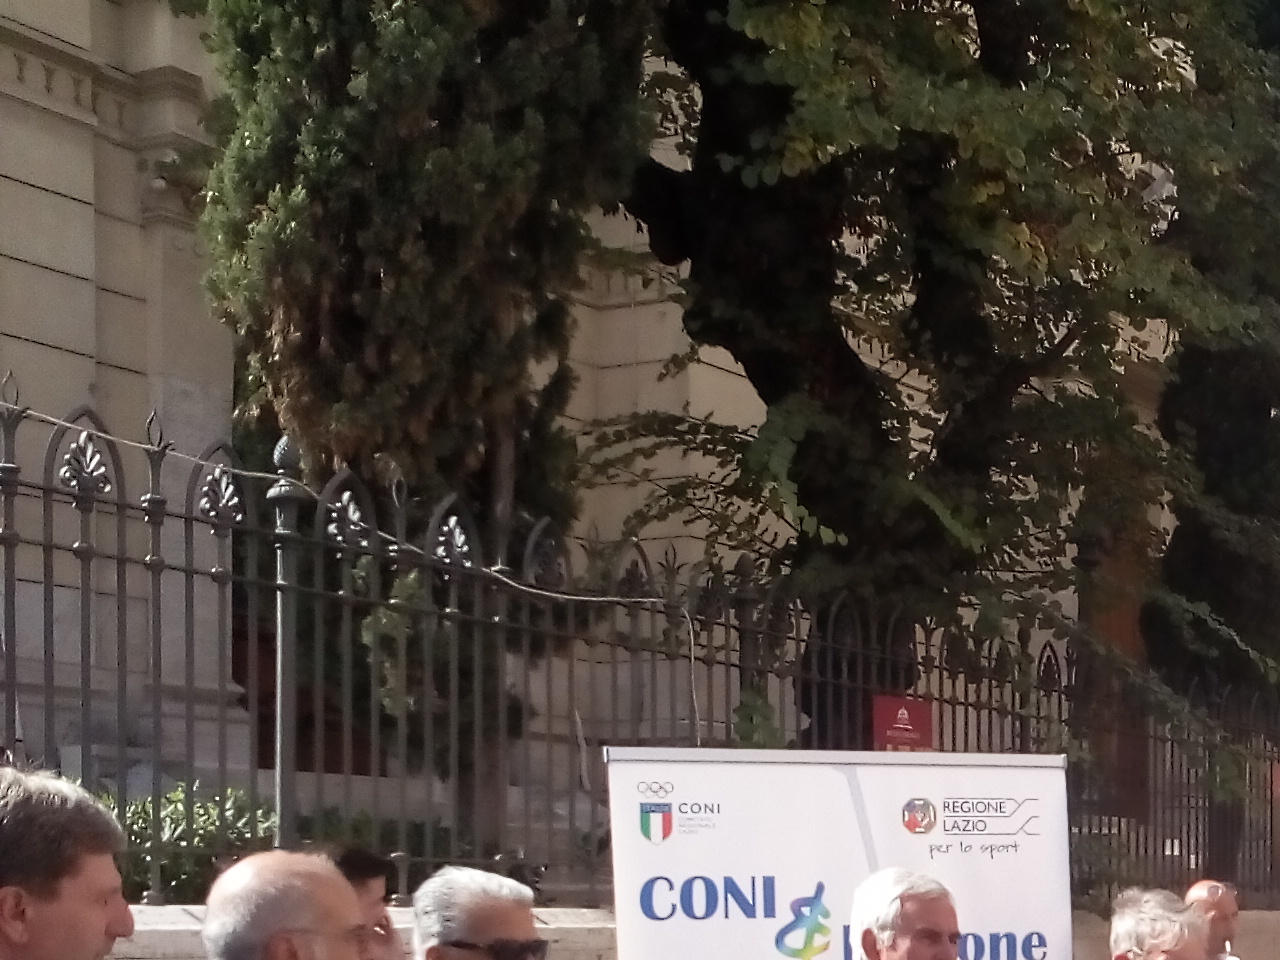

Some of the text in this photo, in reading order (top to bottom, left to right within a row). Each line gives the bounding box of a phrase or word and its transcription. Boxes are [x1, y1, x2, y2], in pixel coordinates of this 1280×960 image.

[678, 802, 721, 815] CONI
[943, 801, 1007, 814] REGIONE
[943, 820, 988, 832] LAZIO
[929, 840, 1020, 860] per lo sport
[639, 875, 777, 921] CONI
